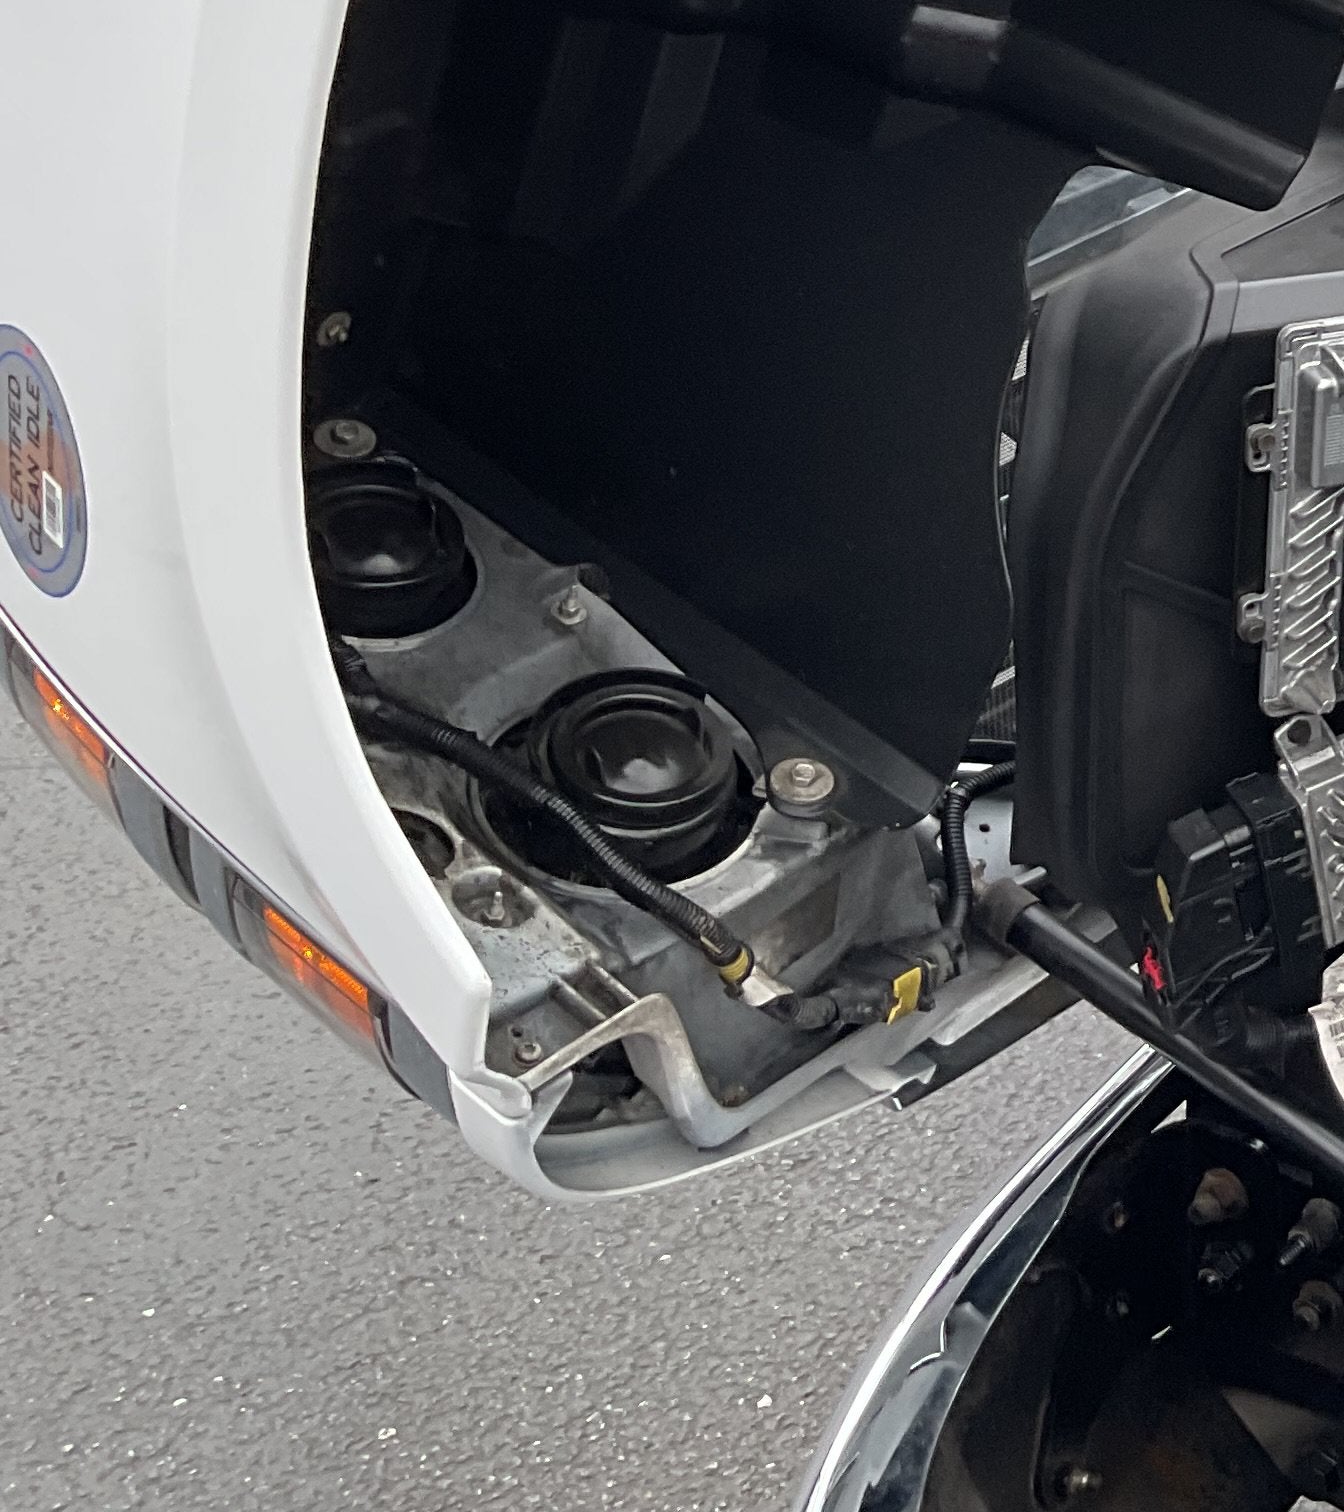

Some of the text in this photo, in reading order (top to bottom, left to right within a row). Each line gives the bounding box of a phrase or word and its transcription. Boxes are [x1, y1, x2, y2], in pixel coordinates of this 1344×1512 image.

[7, 374, 24, 524] CERTIFIED
[25, 375, 43, 556] CLEAN IDLE
